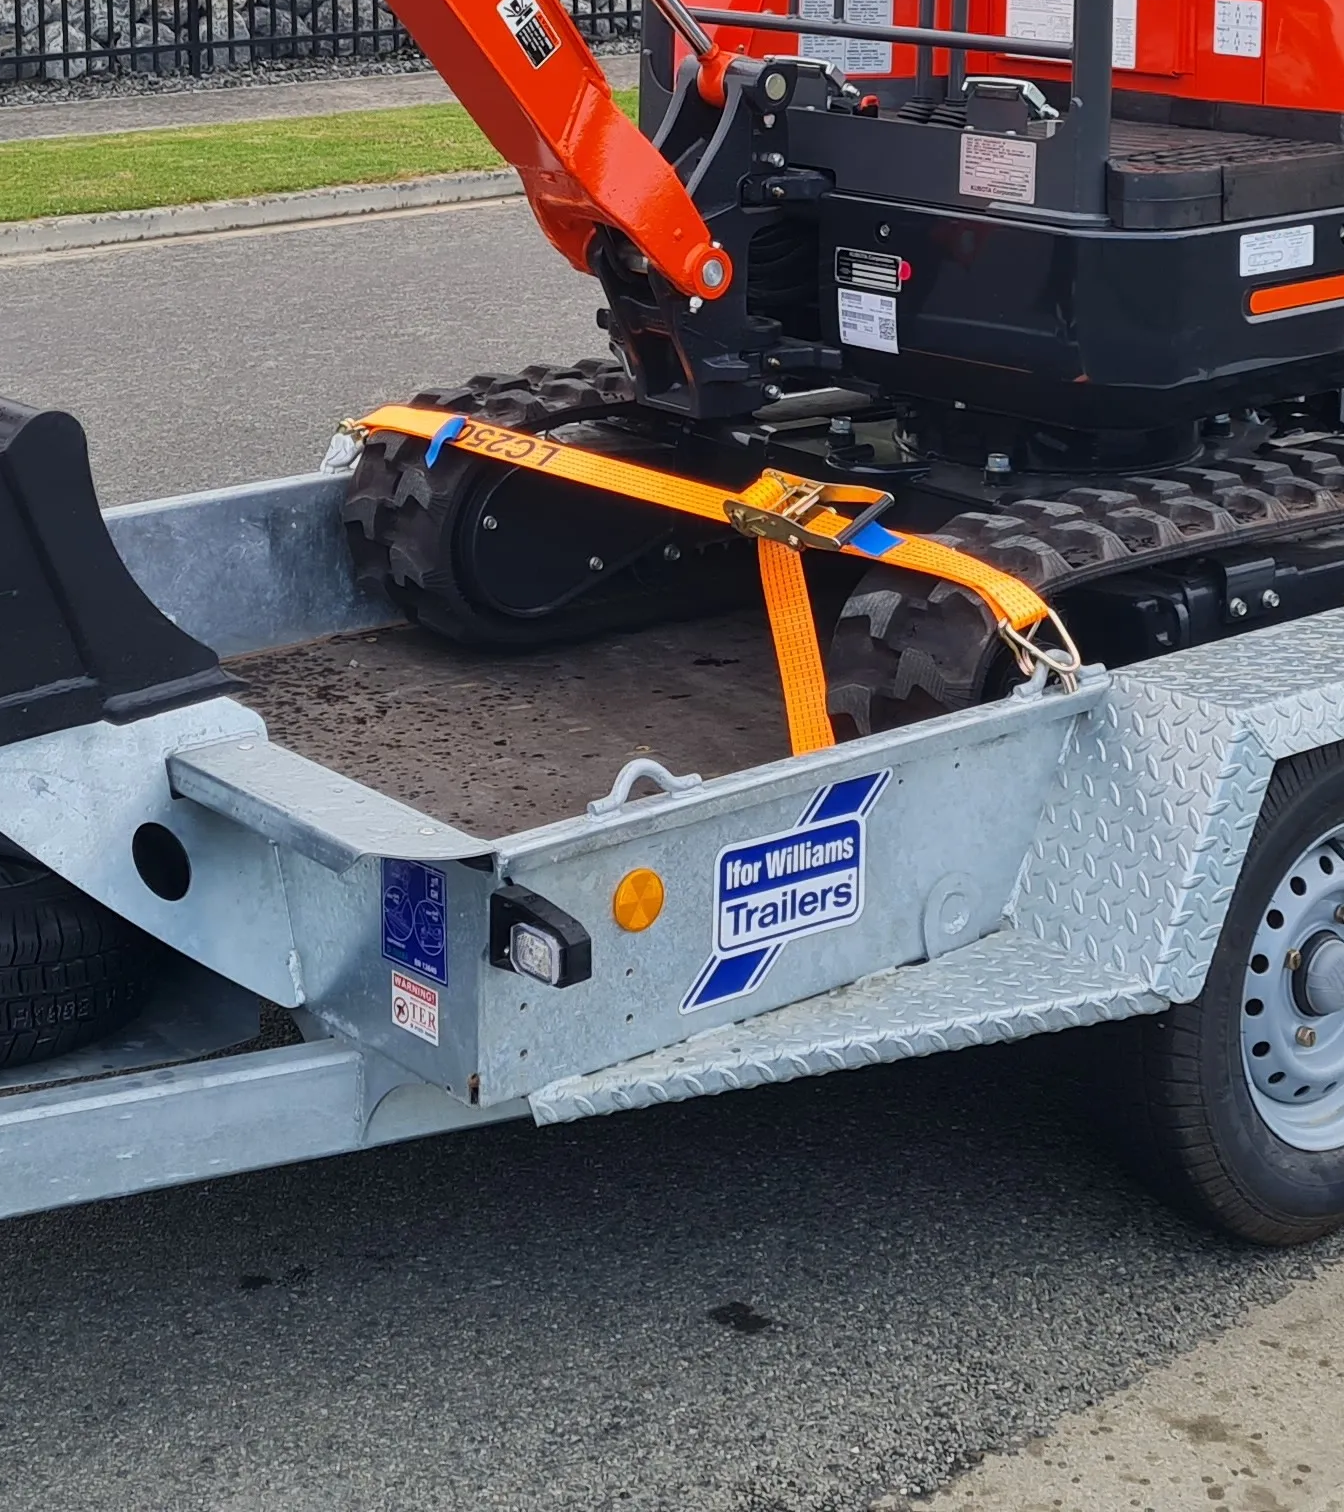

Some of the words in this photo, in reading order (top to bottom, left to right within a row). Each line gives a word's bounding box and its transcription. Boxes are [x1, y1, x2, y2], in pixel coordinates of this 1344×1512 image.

[970, 184, 992, 193] KUBOTA
[726, 858, 762, 891] Ifor
[765, 835, 855, 880] Williams
[725, 881, 853, 936] Trailers
[394, 974, 436, 1004] WARNING!
[409, 1002, 437, 1031] TER
